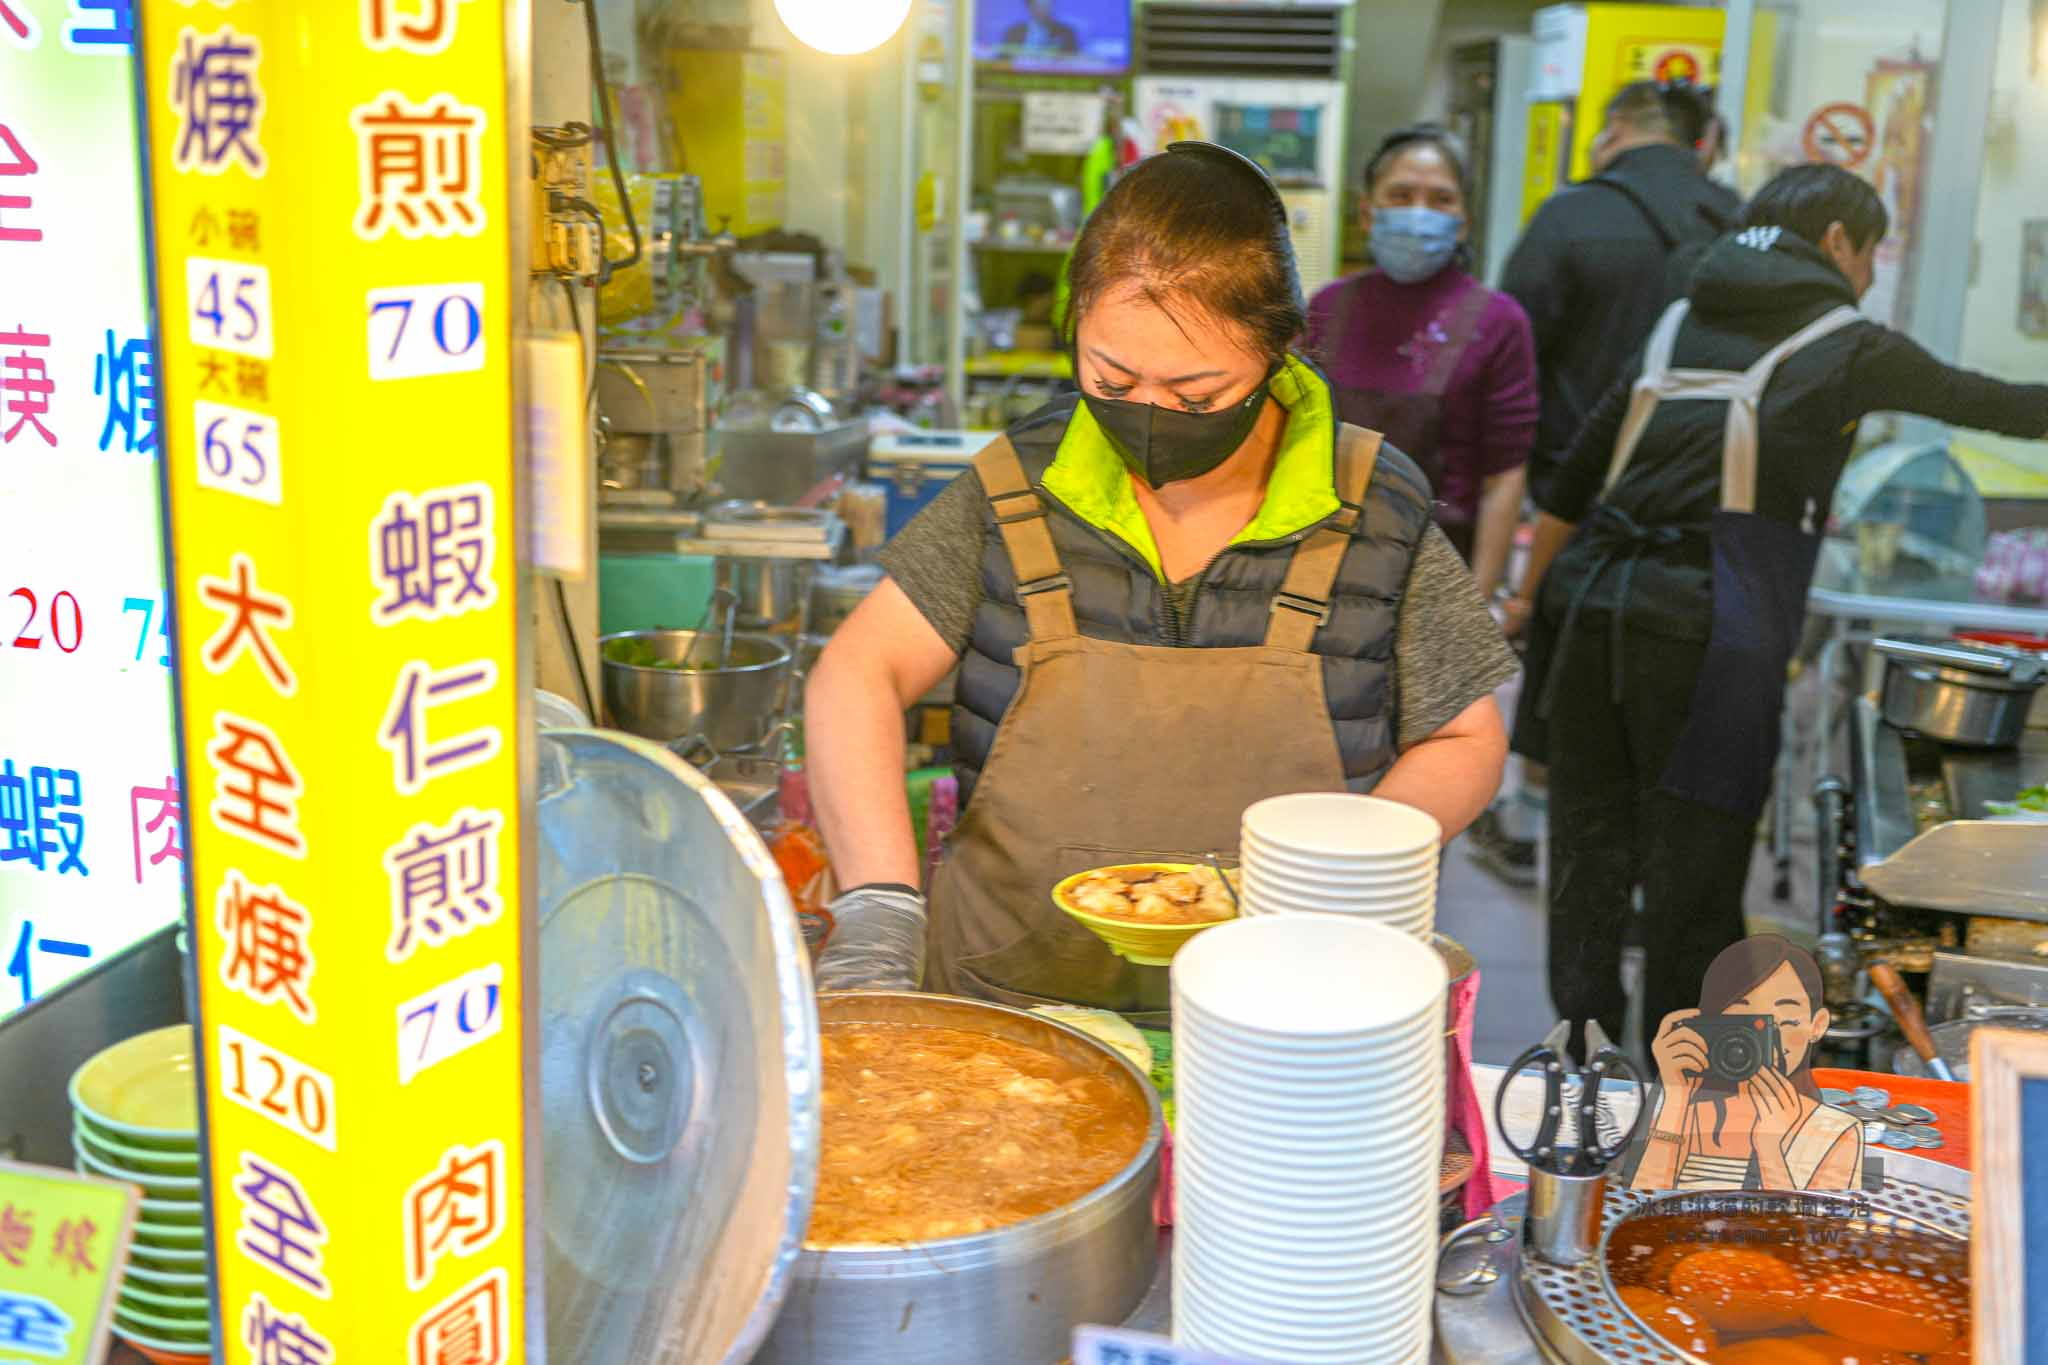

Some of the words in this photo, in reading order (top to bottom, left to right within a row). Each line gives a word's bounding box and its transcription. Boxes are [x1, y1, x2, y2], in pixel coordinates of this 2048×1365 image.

[195, 271, 259, 341] 45
[369, 294, 481, 360] 70
[203, 416, 266, 485] 65
[0, 586, 83, 654] 20
[382, 494, 493, 952] 蝦仁煎
[403, 983, 500, 1062] 70
[228, 1043, 327, 1134] 120
